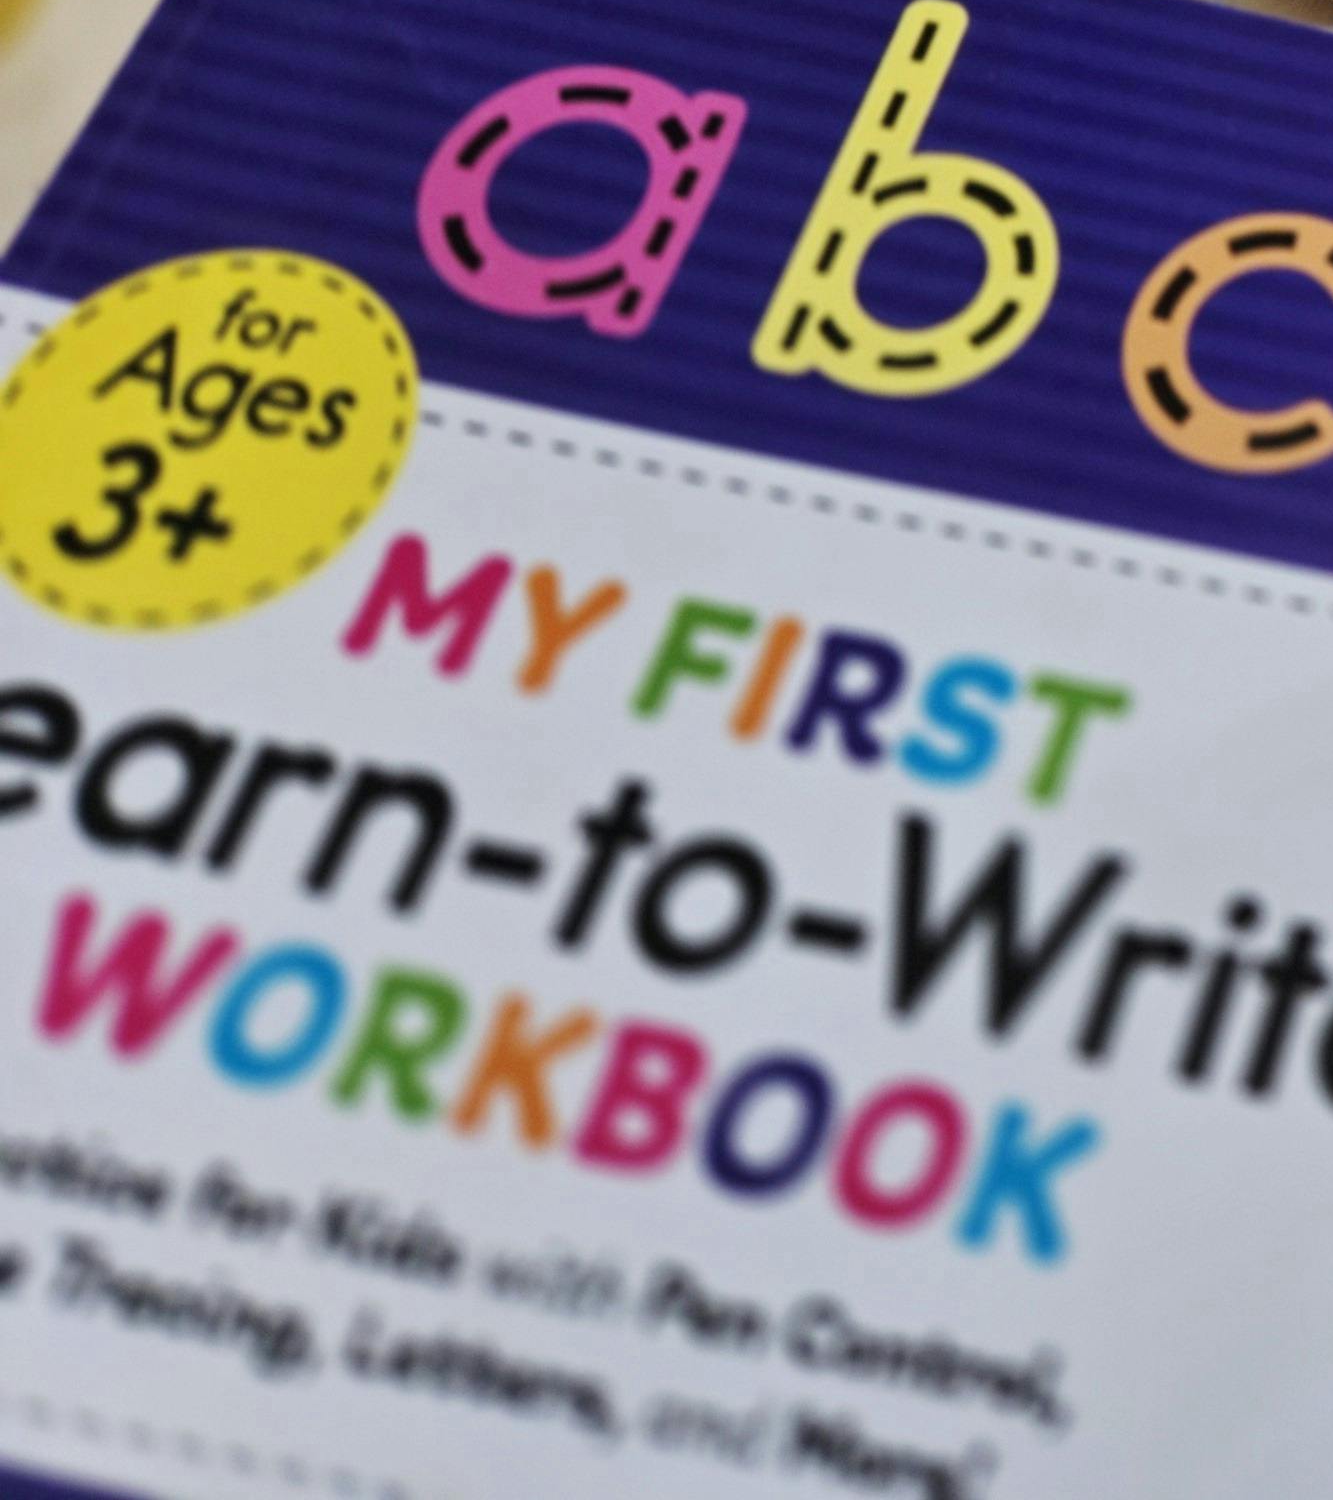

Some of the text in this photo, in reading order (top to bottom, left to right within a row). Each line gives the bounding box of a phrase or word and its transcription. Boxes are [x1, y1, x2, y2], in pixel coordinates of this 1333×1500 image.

[213, 288, 317, 357] for
[93, 323, 358, 451] Ages
[51, 440, 234, 564] 3+
[340, 531, 1132, 805] MY FIRST
[35, 891, 1100, 1266] WORKBOOK
